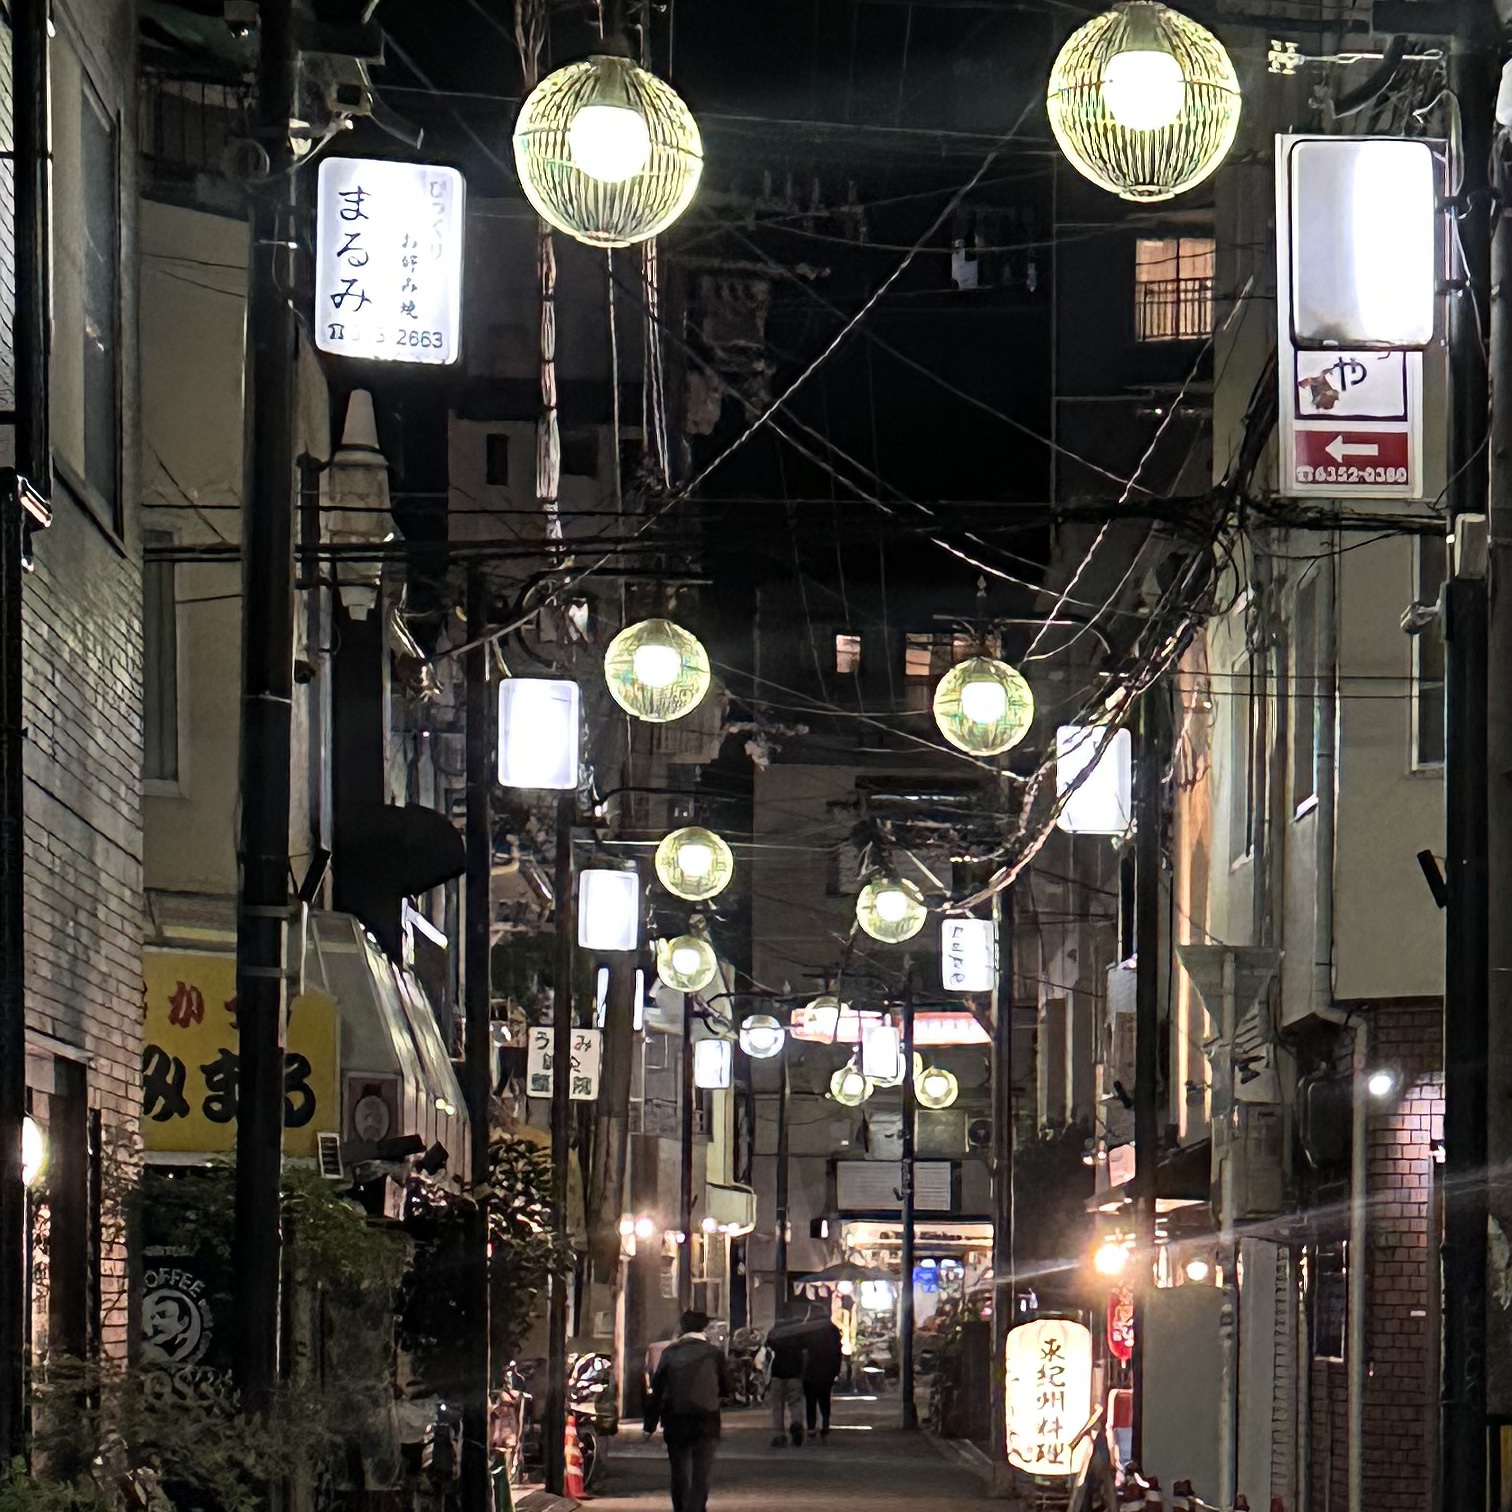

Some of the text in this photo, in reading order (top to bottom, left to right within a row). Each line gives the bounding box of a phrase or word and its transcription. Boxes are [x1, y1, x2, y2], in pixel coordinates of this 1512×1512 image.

[330, 185, 372, 313] まるみ
[144, 1267, 207, 1299] OFFEE
